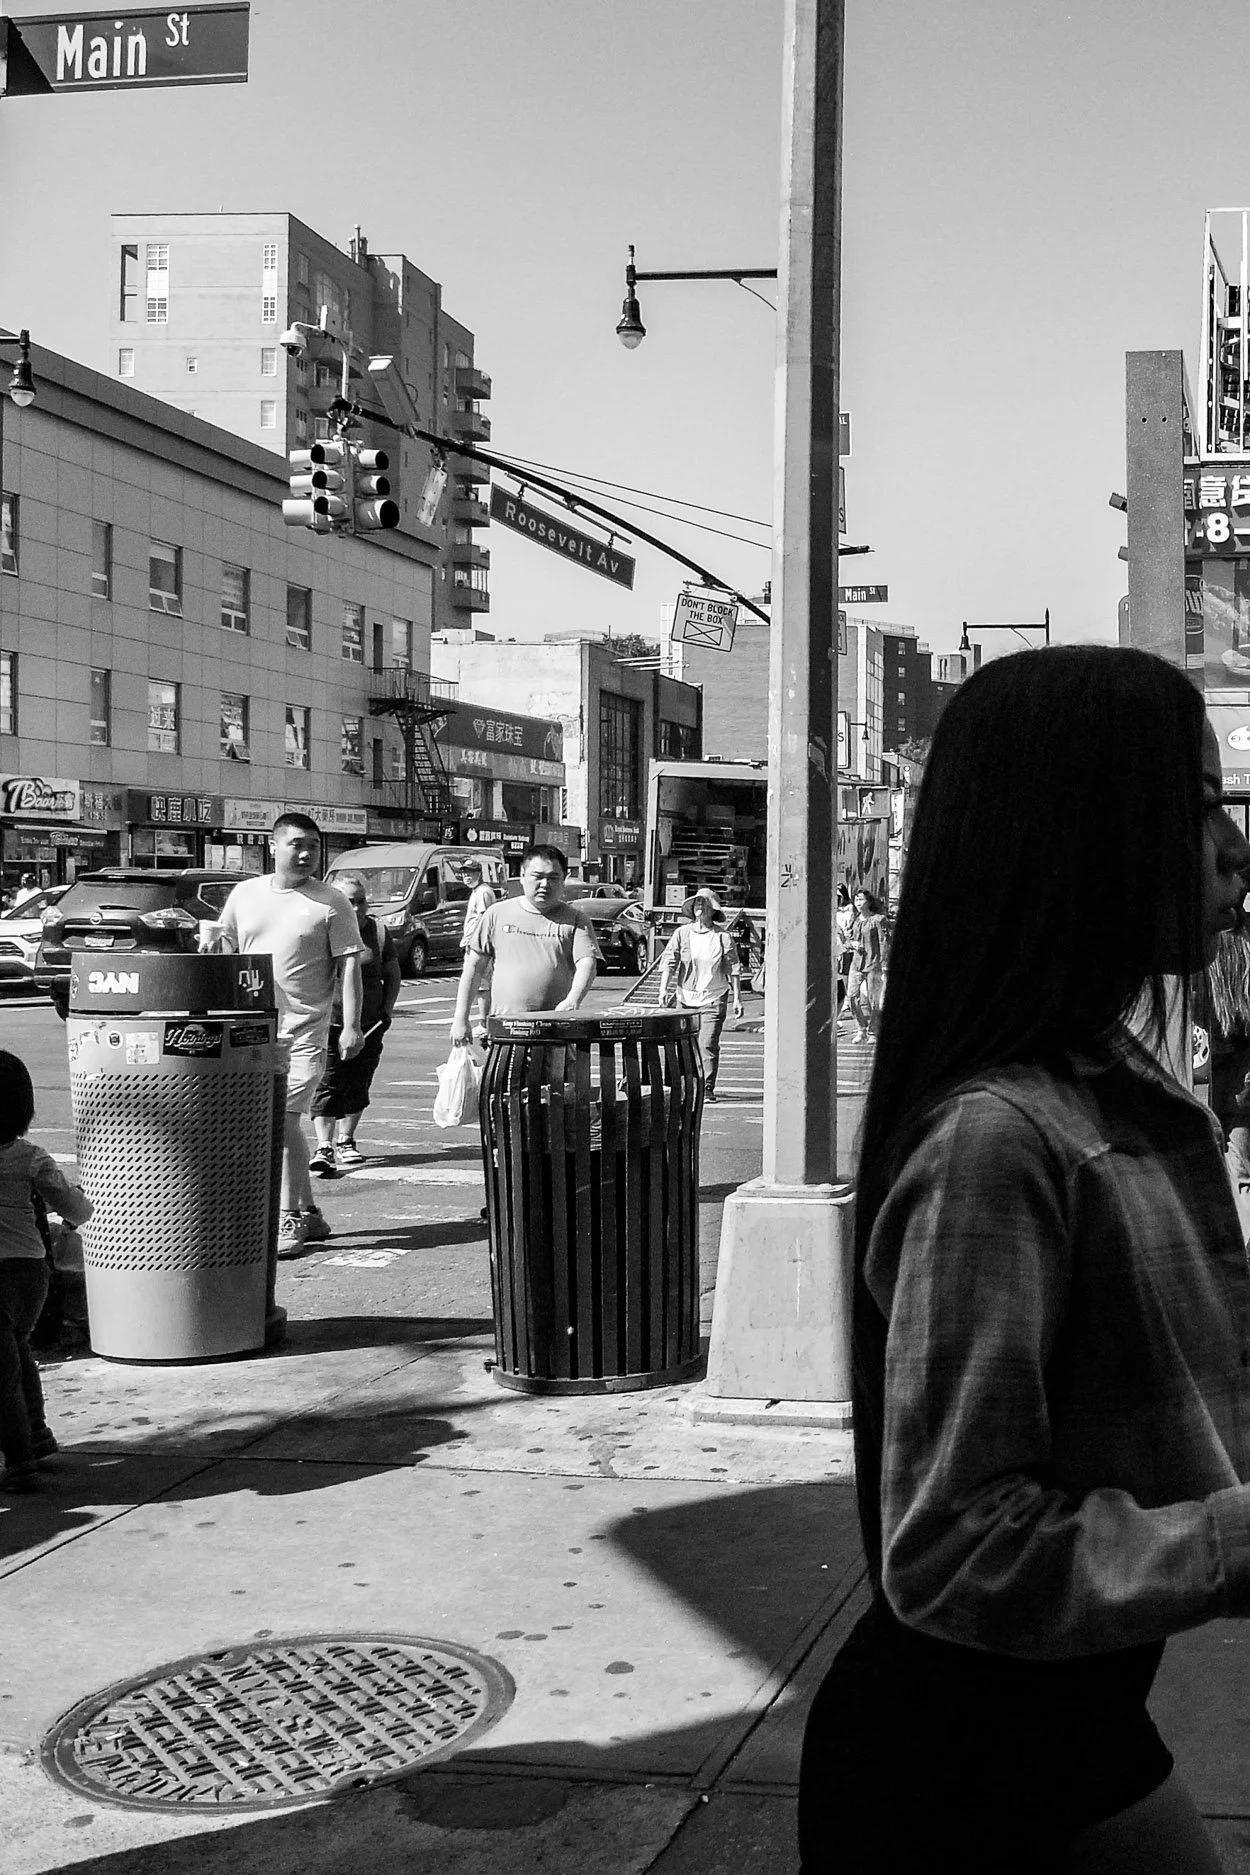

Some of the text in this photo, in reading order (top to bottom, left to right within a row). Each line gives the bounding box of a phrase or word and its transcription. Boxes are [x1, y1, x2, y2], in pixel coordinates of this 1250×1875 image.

[56, 12, 190, 80] Main St
[505, 501, 619, 574] Roosevelt Av
[844, 588, 867, 602] Main
[681, 598, 734, 618] DON'T BLOCK
[689, 610, 723, 625] THE BOX
[1222, 773, 1241, 785] esh
[88, 971, 140, 994] NYC
